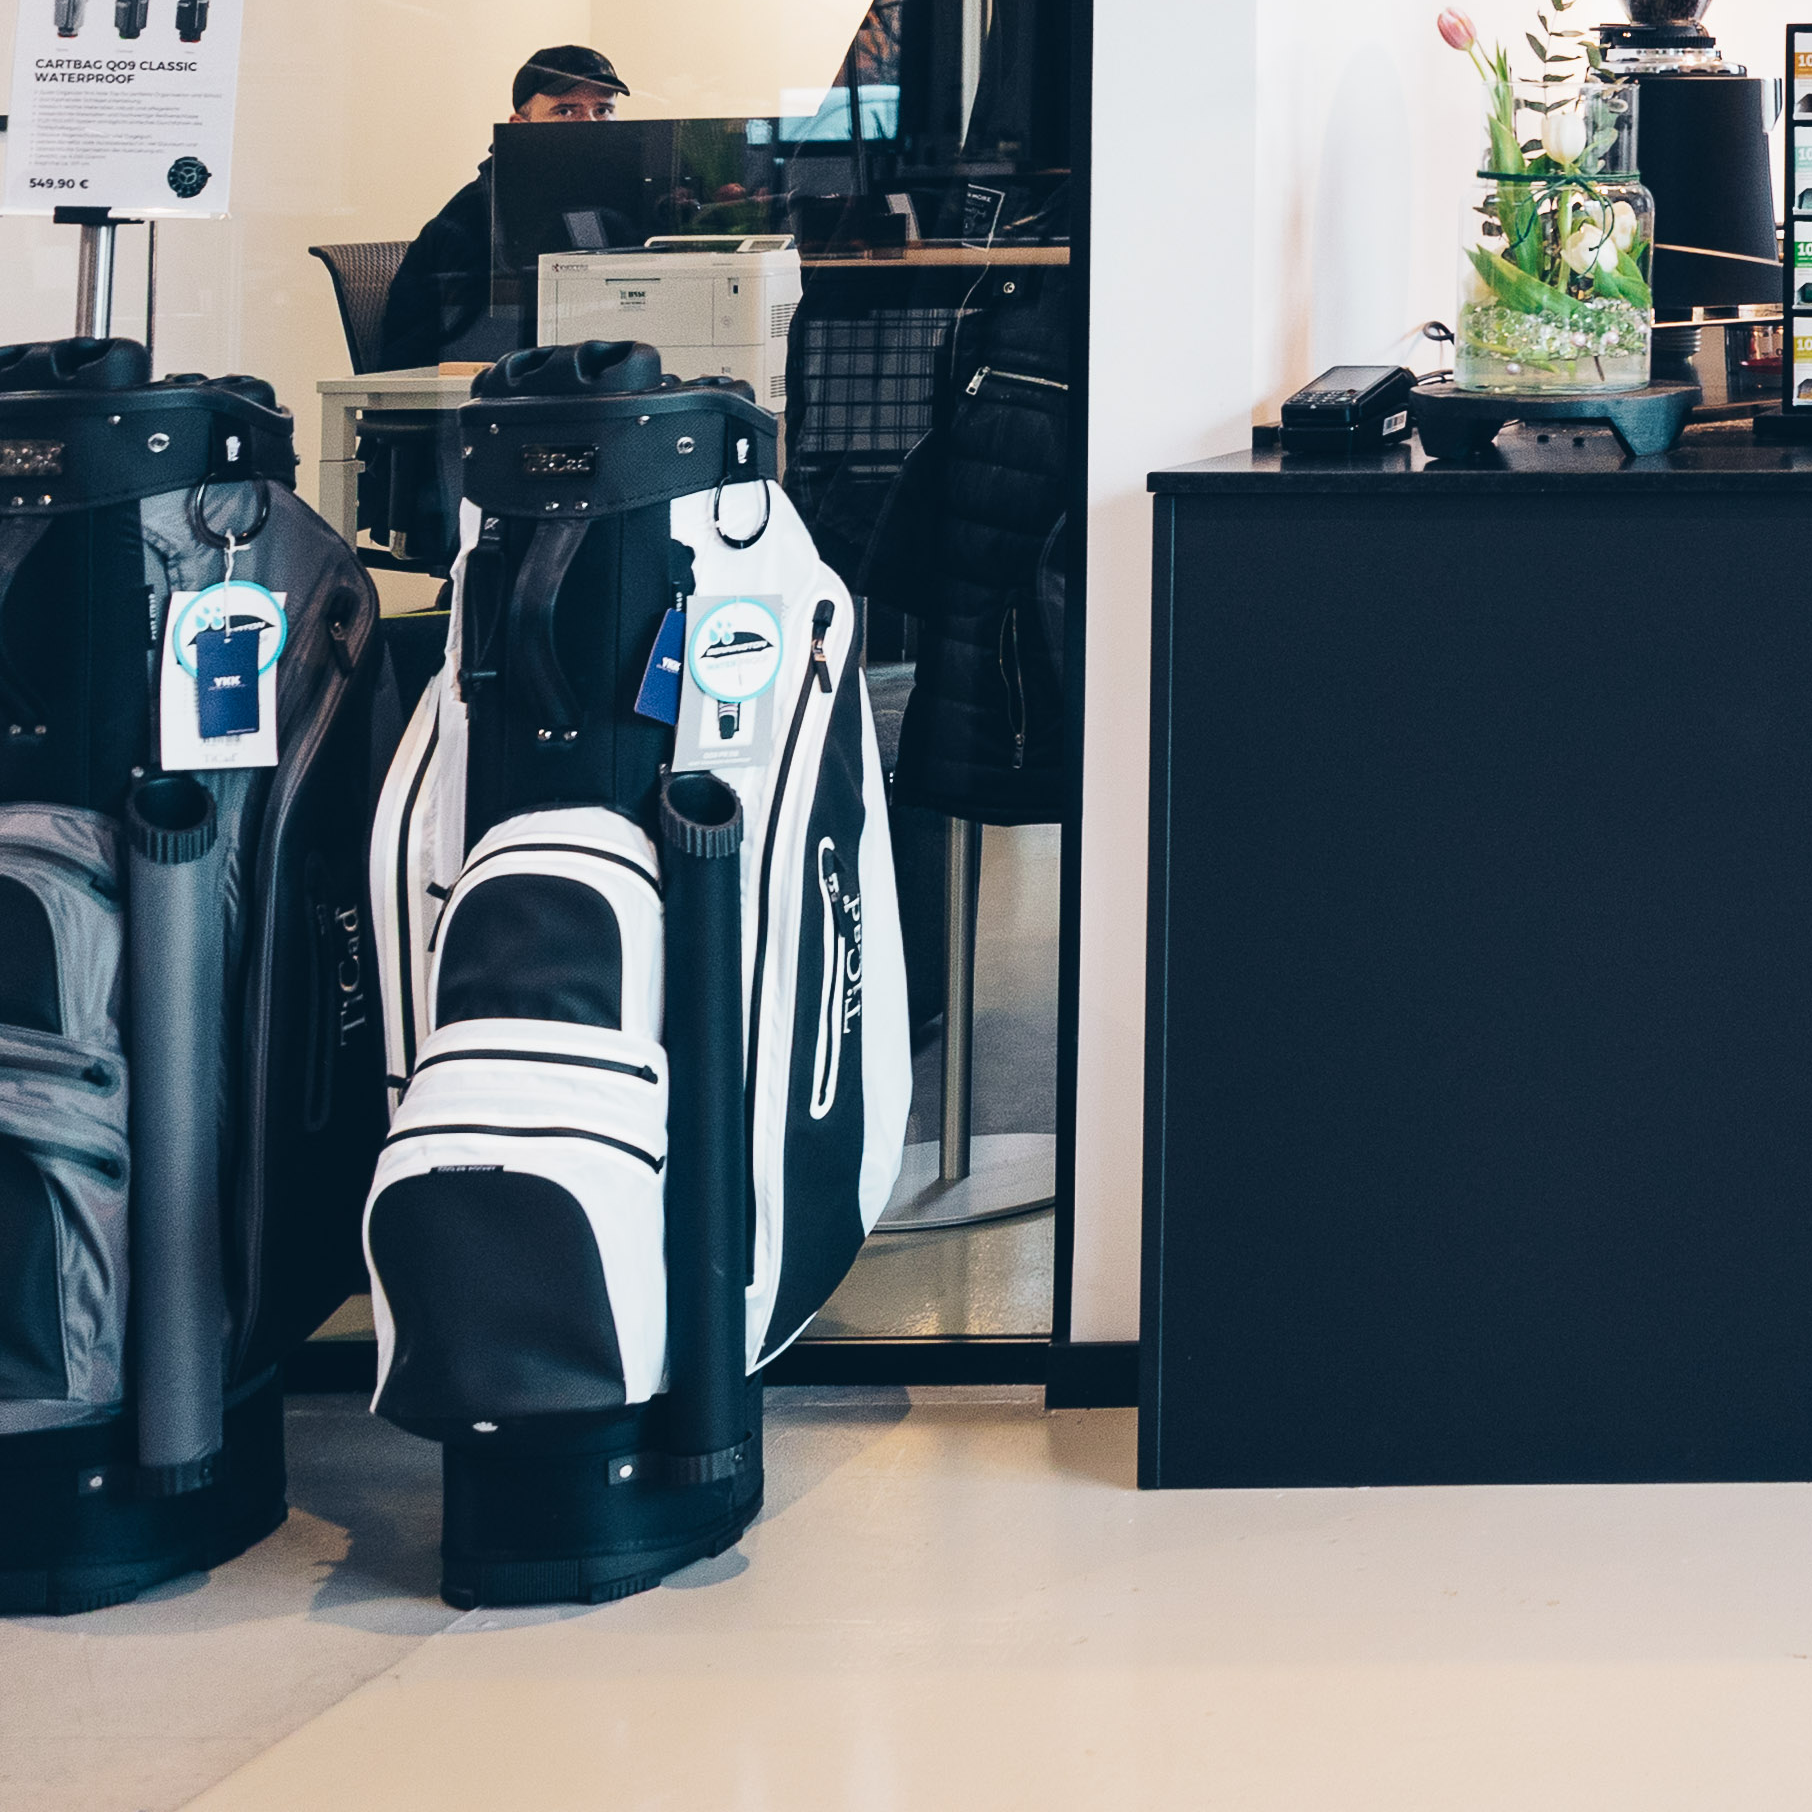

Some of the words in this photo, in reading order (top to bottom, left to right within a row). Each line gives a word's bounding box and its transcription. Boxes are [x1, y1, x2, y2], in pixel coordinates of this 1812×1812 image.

[35, 59, 102, 71] CARTBAG
[139, 61, 198, 72] CLASSIC
[35, 73, 135, 84] WATERPROOF
[29, 178, 75, 189] 549,90
[79, 179, 89, 189] €
[334, 904, 366, 1047] TiCad
